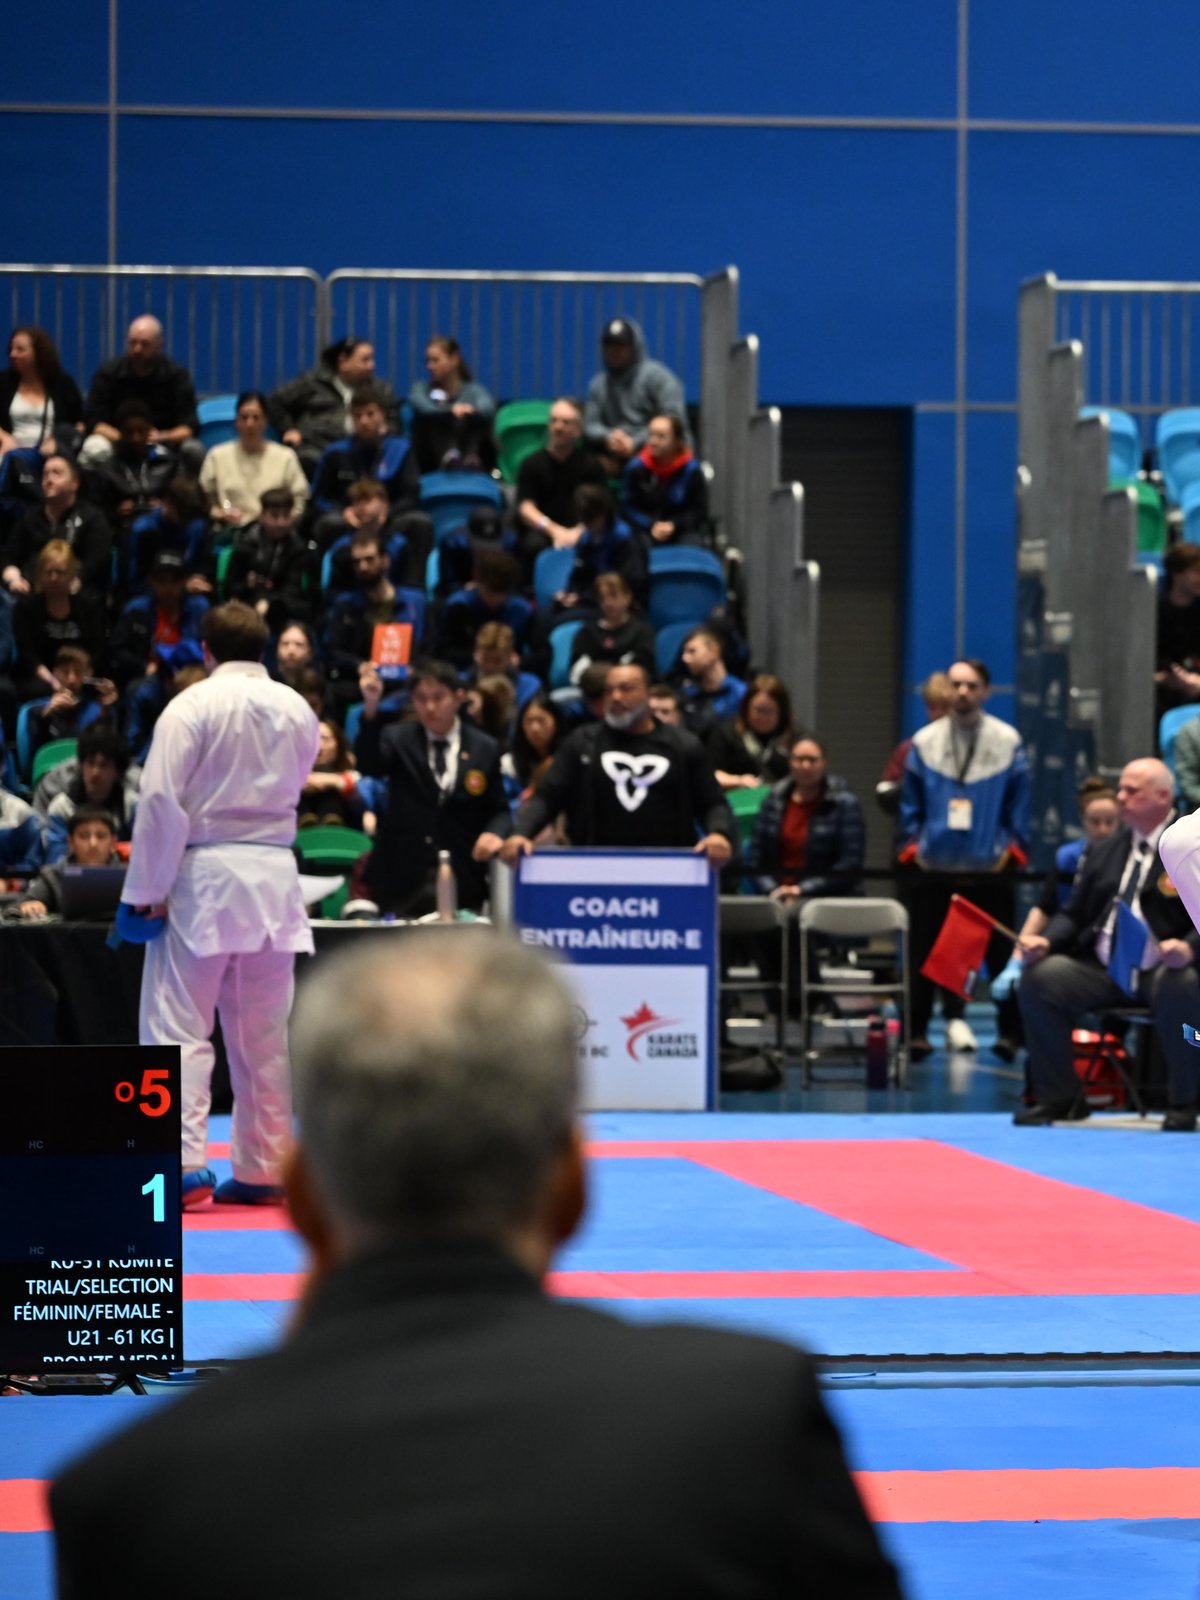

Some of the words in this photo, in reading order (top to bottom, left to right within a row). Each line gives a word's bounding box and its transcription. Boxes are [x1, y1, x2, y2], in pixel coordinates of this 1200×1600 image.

[568, 897, 659, 918] COACH
[141, 1173, 165, 1222] 1
[25, 1278, 173, 1296] TRIAL/SELECTION
[14, 1302, 161, 1322] FÉMININ/FEMALE
[68, 1330, 99, 1346] U21
[107, 1329, 133, 1345] -61
[141, 1329, 164, 1344] KG
